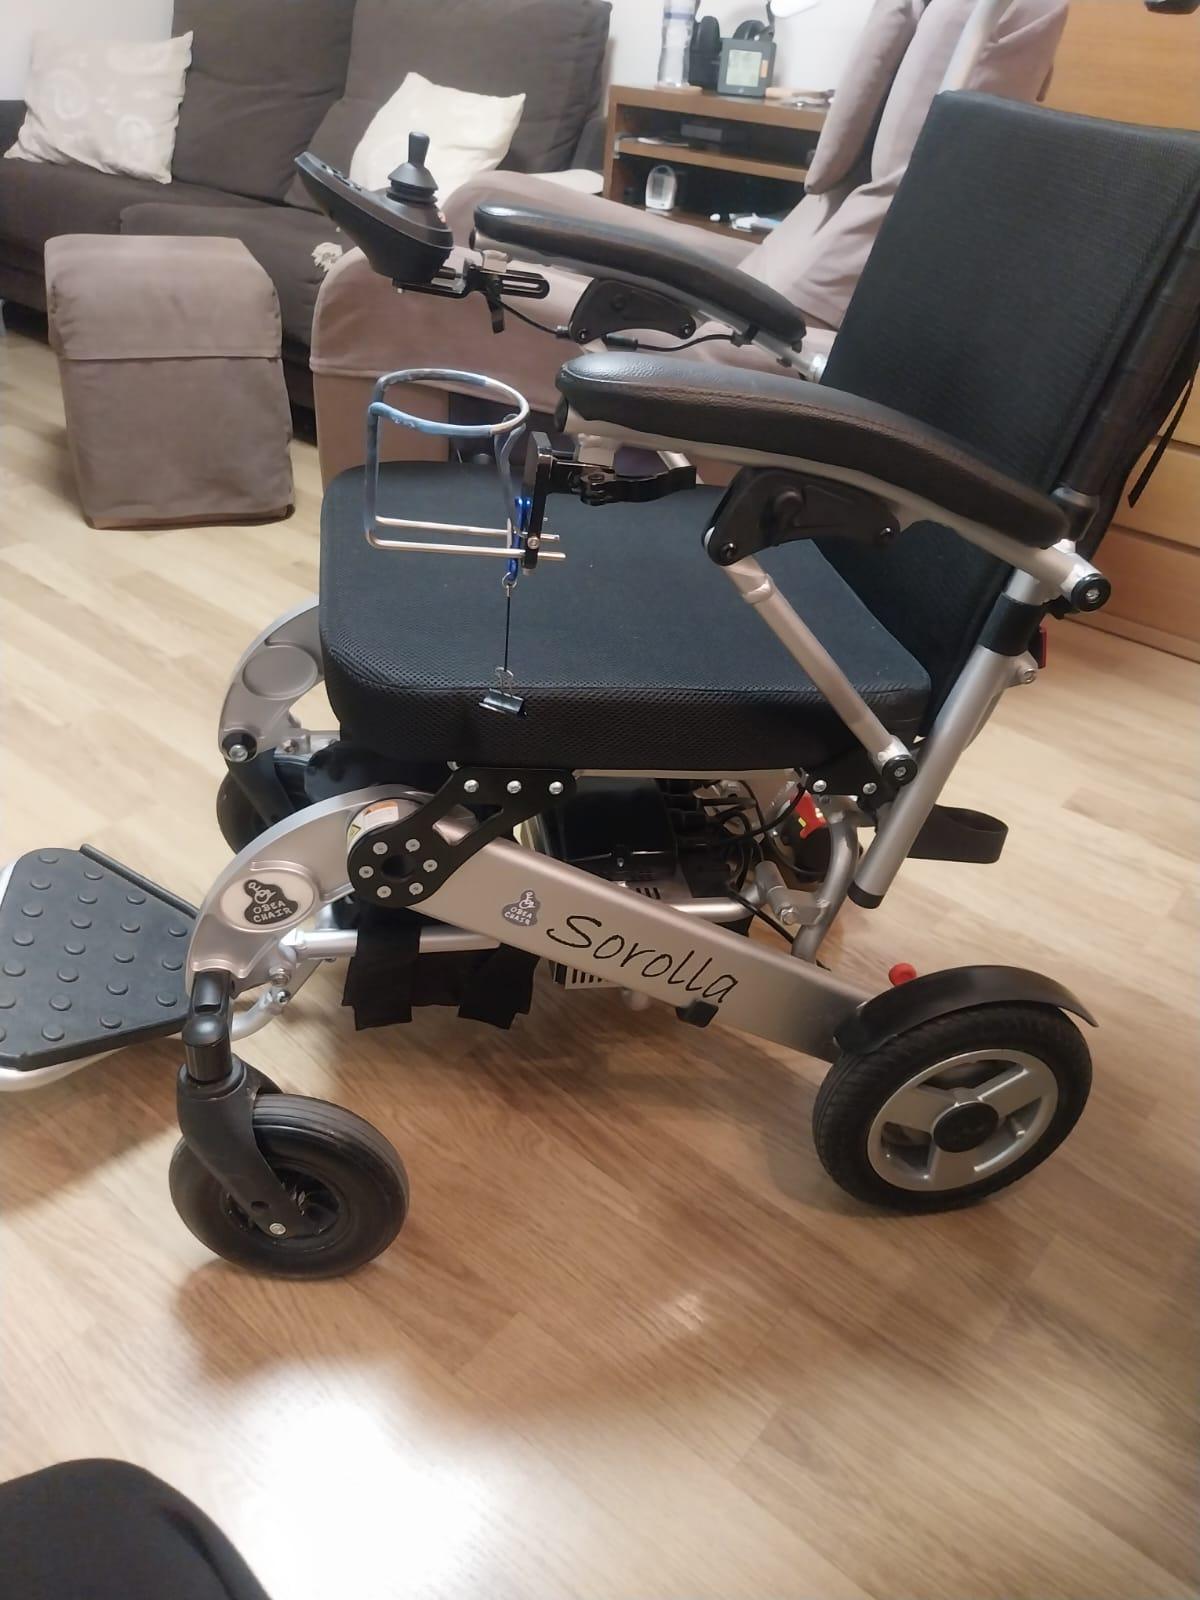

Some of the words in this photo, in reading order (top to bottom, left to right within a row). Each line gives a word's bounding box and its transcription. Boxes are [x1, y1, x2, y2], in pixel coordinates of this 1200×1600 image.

[253, 900, 286, 914] OBEA
[253, 907, 293, 923] CHAIR
[546, 915, 739, 1003] Sorolla
